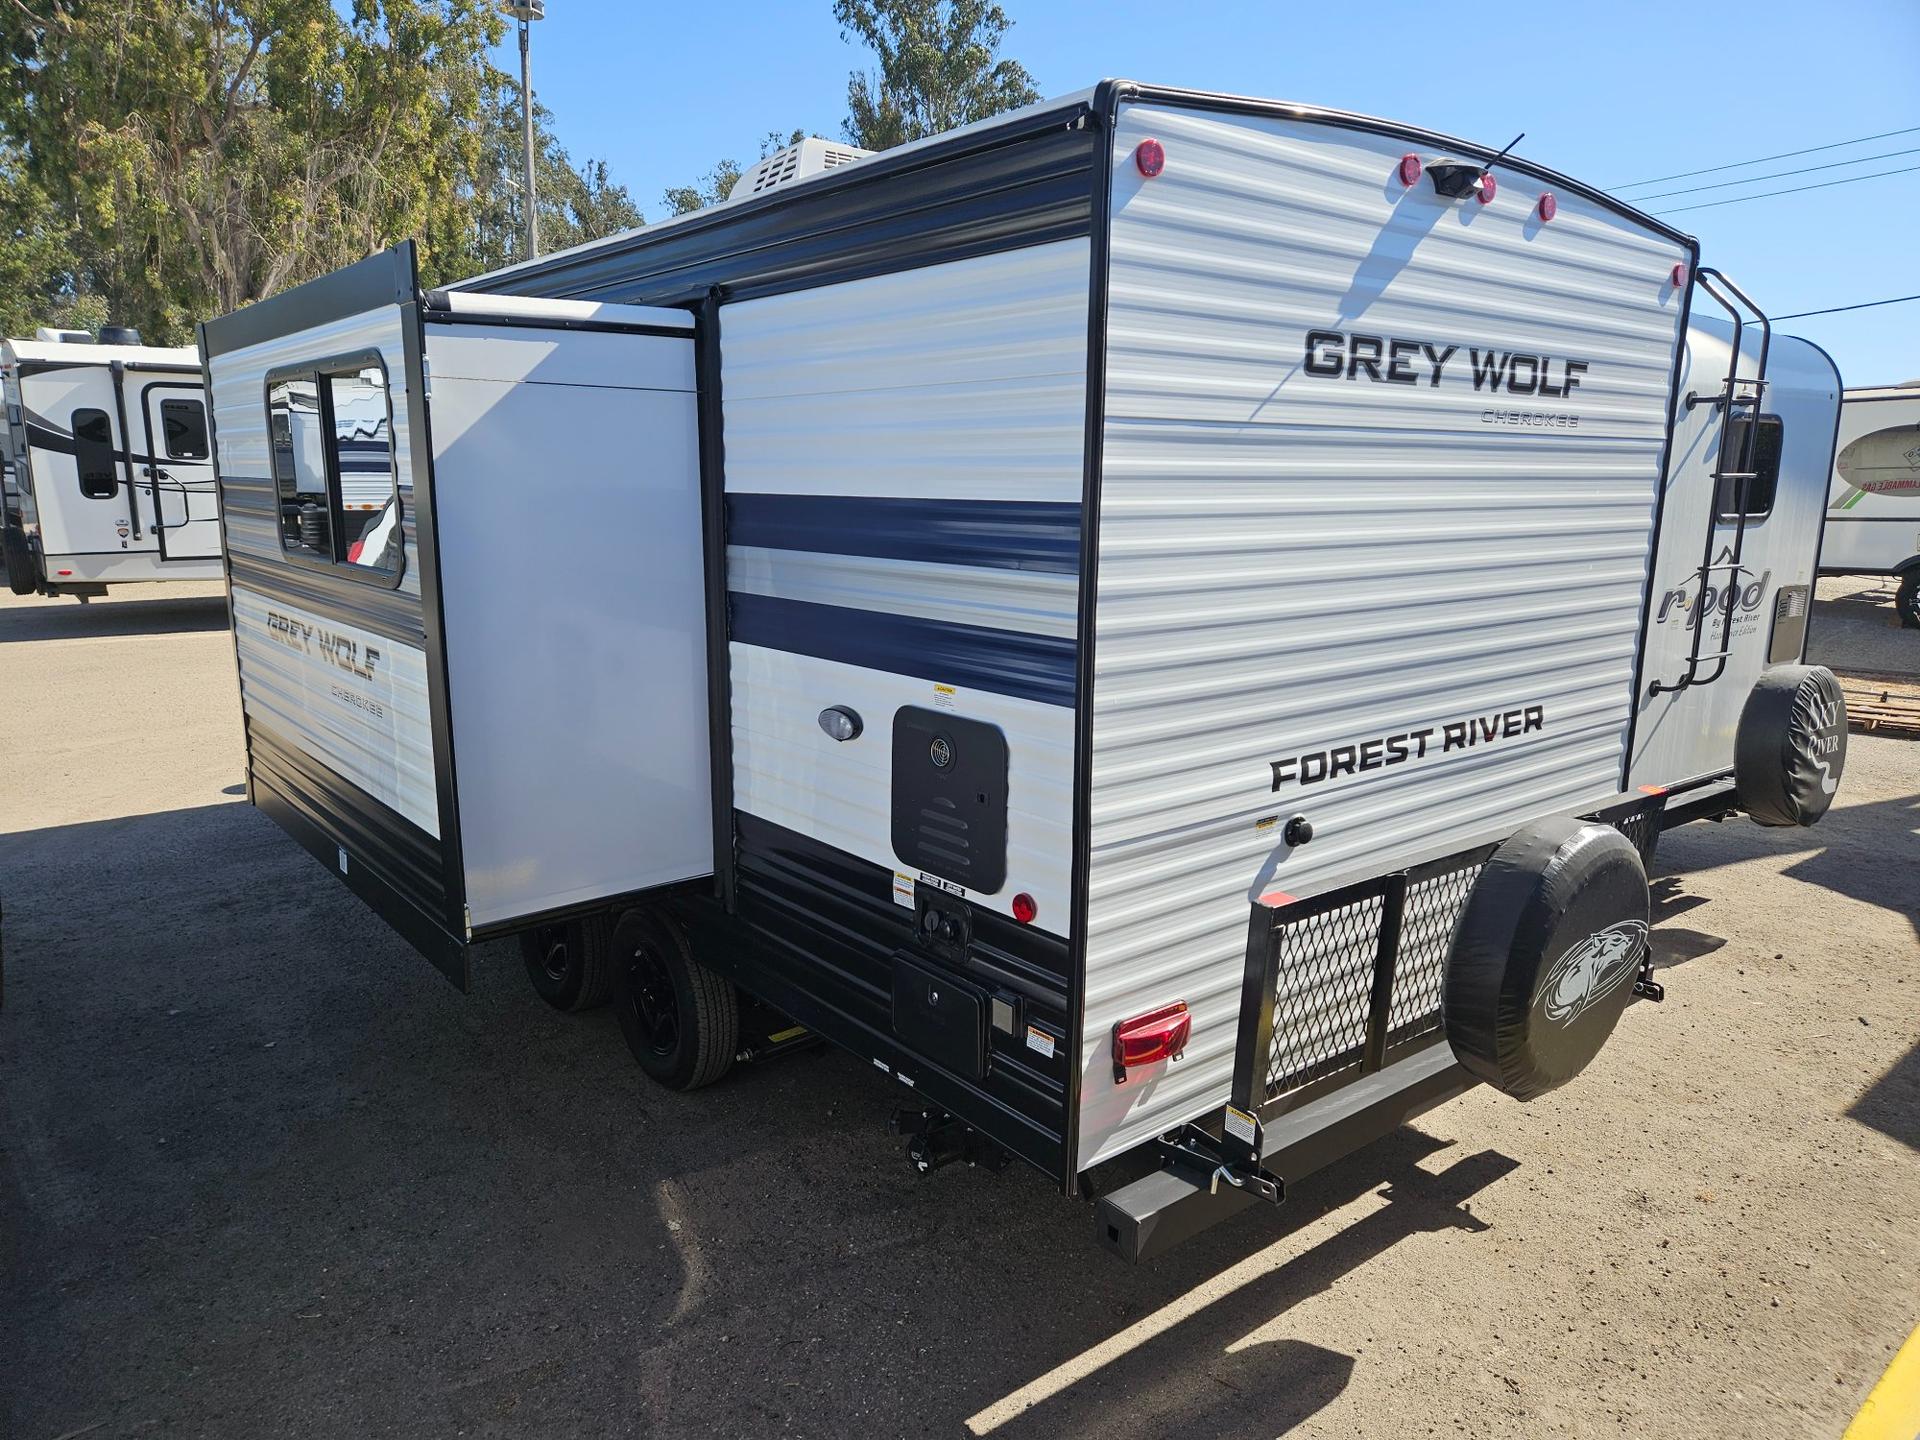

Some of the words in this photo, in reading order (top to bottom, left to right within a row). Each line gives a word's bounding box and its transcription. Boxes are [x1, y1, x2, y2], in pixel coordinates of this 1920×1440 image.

[1304, 328, 1460, 388] GREY
[1469, 347, 1590, 398] WOLF
[1480, 408, 1580, 428] CHEROKEE
[267, 611, 313, 656] GREY
[317, 627, 380, 682] WOLF
[330, 684, 384, 720] CHEROKEE
[1808, 693, 1842, 732] SKY
[1269, 728, 1434, 793] FOREST
[1442, 705, 1544, 753] RIVER
[1807, 734, 1839, 760] RIVER
